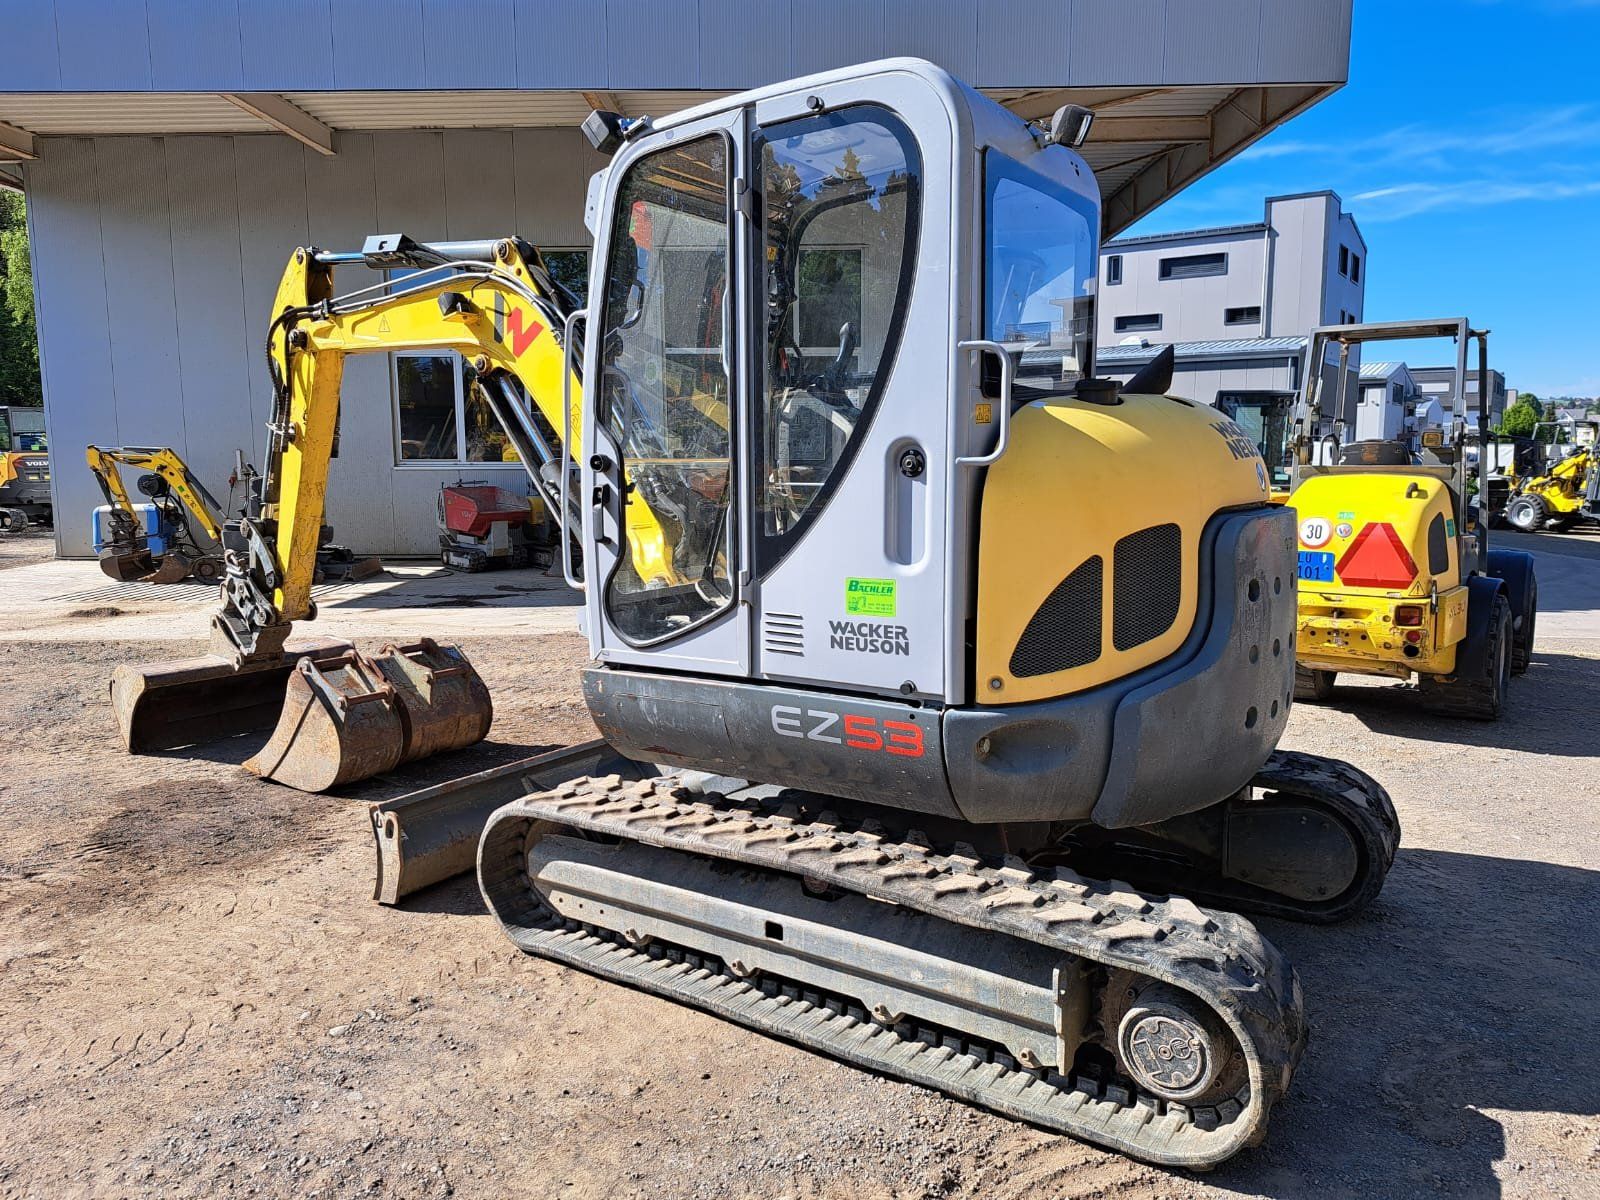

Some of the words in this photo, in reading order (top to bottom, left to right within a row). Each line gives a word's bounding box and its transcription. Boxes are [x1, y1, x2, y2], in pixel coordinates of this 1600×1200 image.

[1306, 524, 1323, 540] 30
[1297, 551, 1312, 563] LU
[828, 620, 909, 641] WACKER
[830, 634, 910, 656] NEUSON
[771, 705, 924, 757] EZ53
